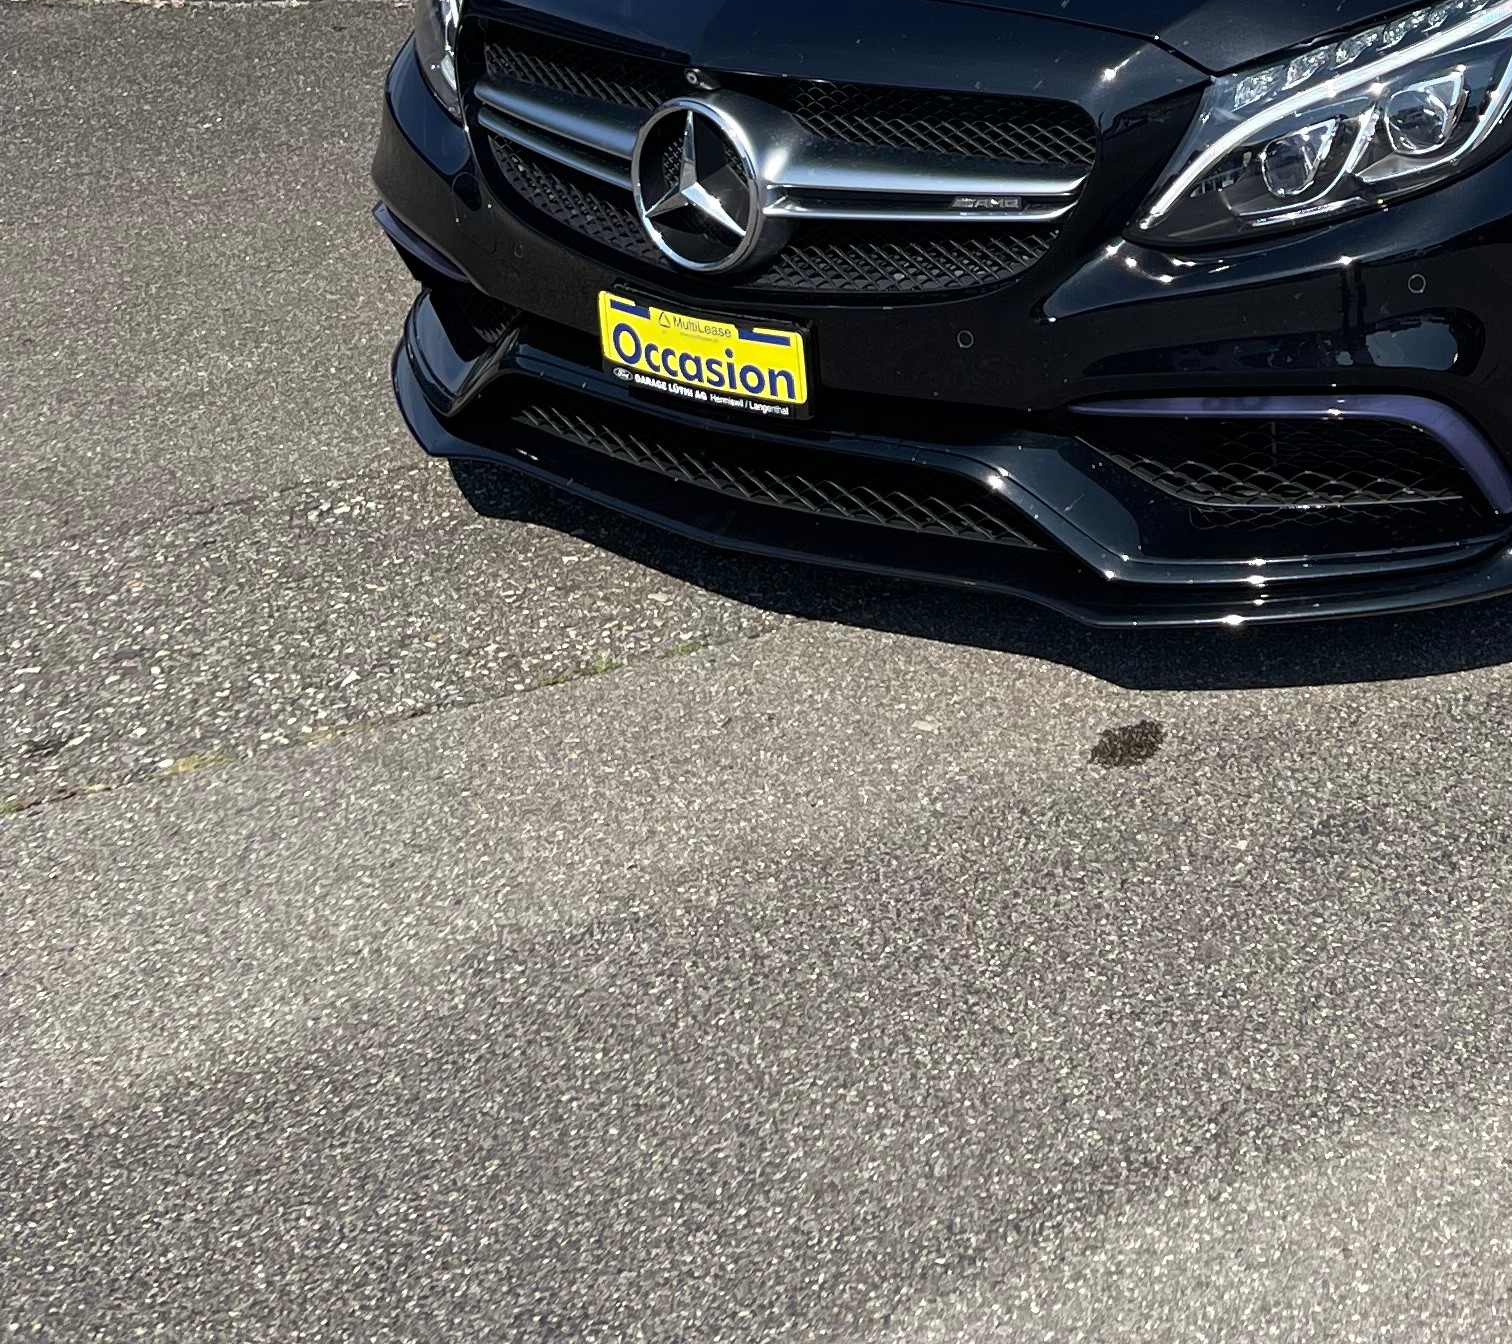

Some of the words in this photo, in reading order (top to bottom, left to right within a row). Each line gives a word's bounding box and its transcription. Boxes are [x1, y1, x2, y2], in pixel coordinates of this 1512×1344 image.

[974, 198, 1019, 208] AMG
[672, 315, 732, 338] MultiLease
[612, 322, 796, 400] Occasion
[634, 373, 667, 391] GARAGE
[694, 390, 708, 401] AG
[749, 400, 790, 416] Langenthal
